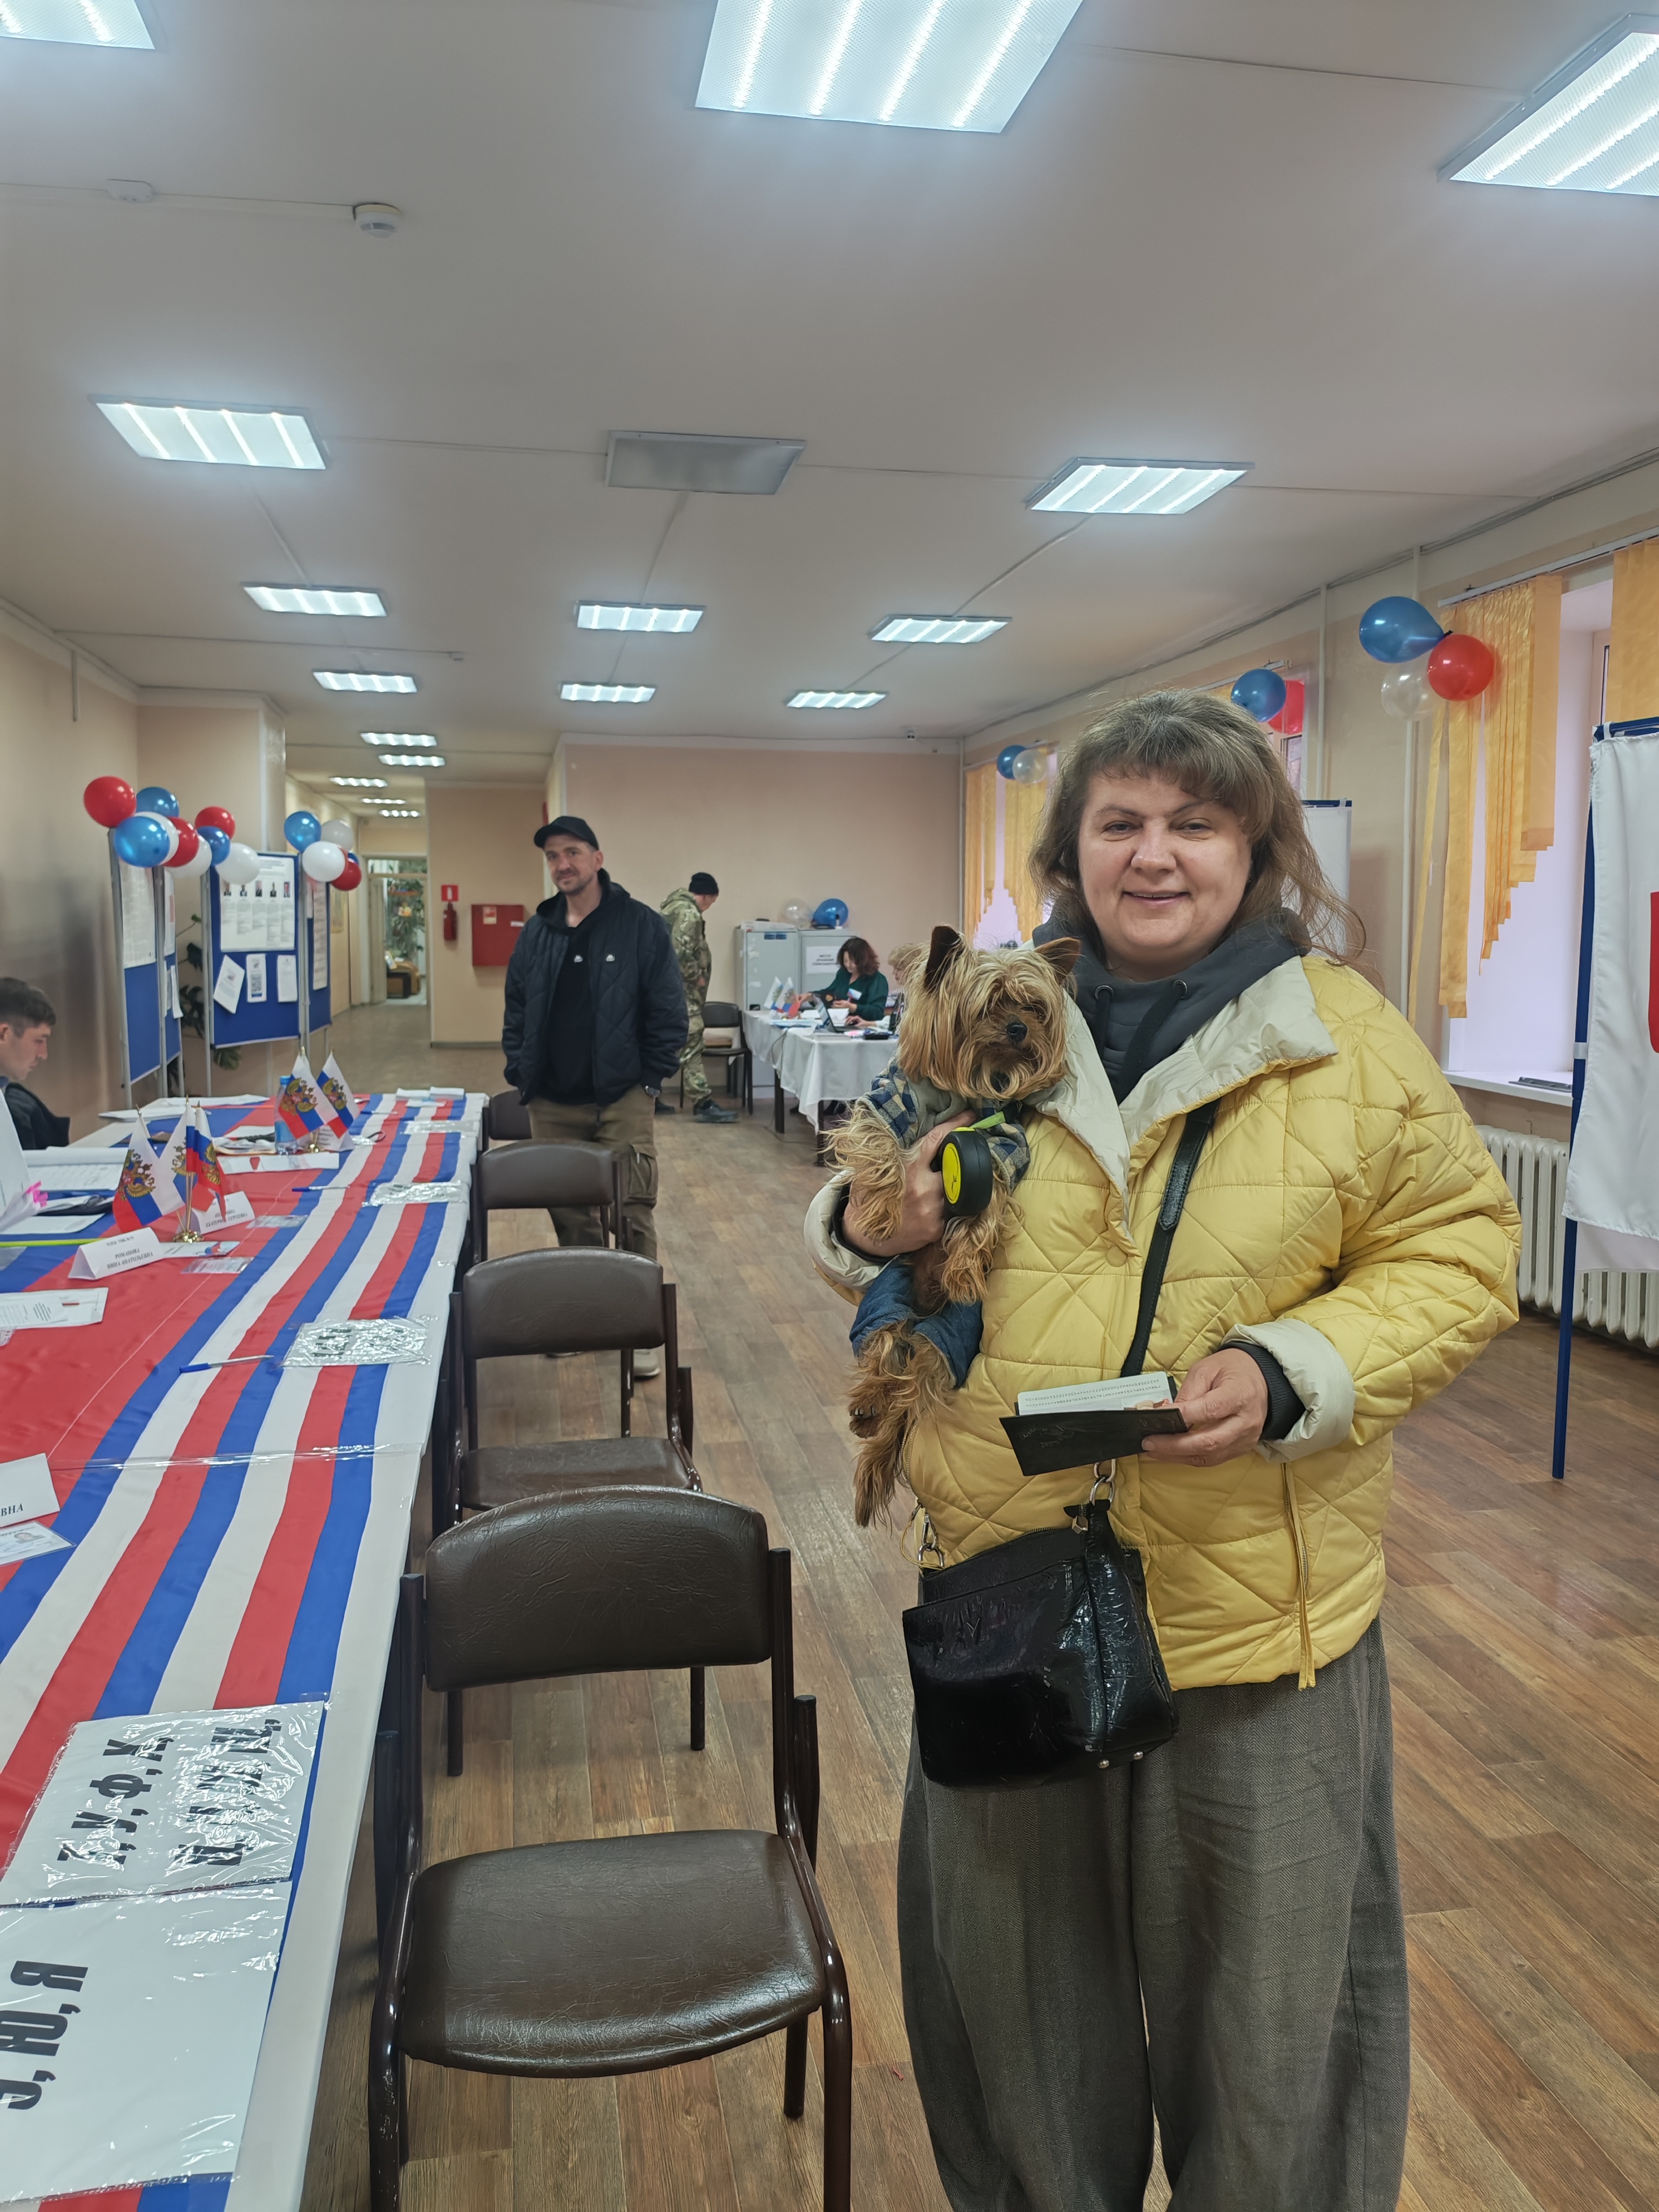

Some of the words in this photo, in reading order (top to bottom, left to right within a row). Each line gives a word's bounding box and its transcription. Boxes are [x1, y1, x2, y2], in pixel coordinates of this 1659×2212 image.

[0, 1503, 24, 1517] ВНА
[90, 1769, 163, 1799] Ф,
[10, 1960, 89, 1992] Я
[0, 2004, 81, 2056] Ю,
